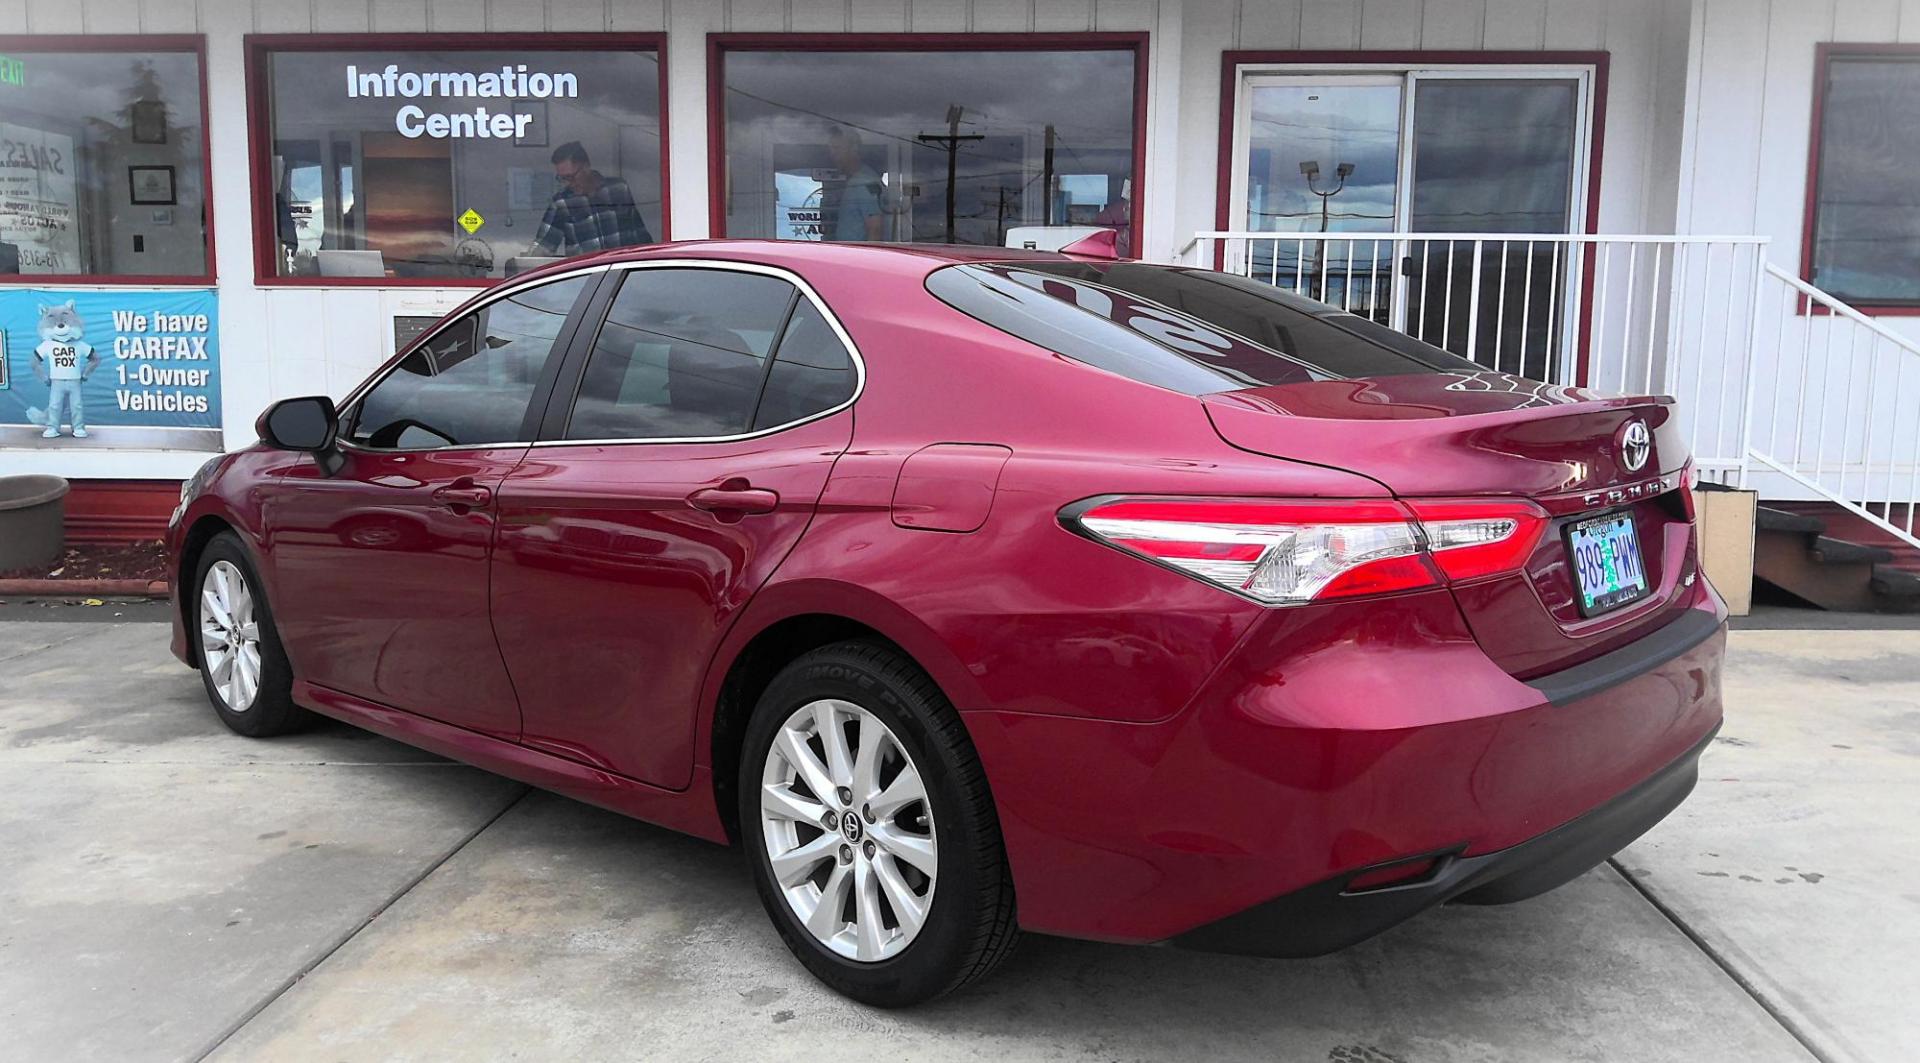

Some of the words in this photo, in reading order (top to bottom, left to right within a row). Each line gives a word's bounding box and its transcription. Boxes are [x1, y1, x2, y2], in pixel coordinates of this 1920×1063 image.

[346, 64, 578, 98] Information
[396, 105, 533, 138] Center
[787, 212, 823, 222] WORL
[112, 310, 147, 332] We
[153, 310, 208, 333] have
[53, 346, 76, 357] CAR
[113, 336, 208, 360] CARFAX
[55, 356, 76, 368] FOX
[116, 363, 210, 387] 1-Owner
[116, 389, 208, 413] Vehicles
[1588, 522, 1614, 538] Oregon
[1575, 543, 1605, 591] 989
[1610, 532, 1641, 581] PWM
